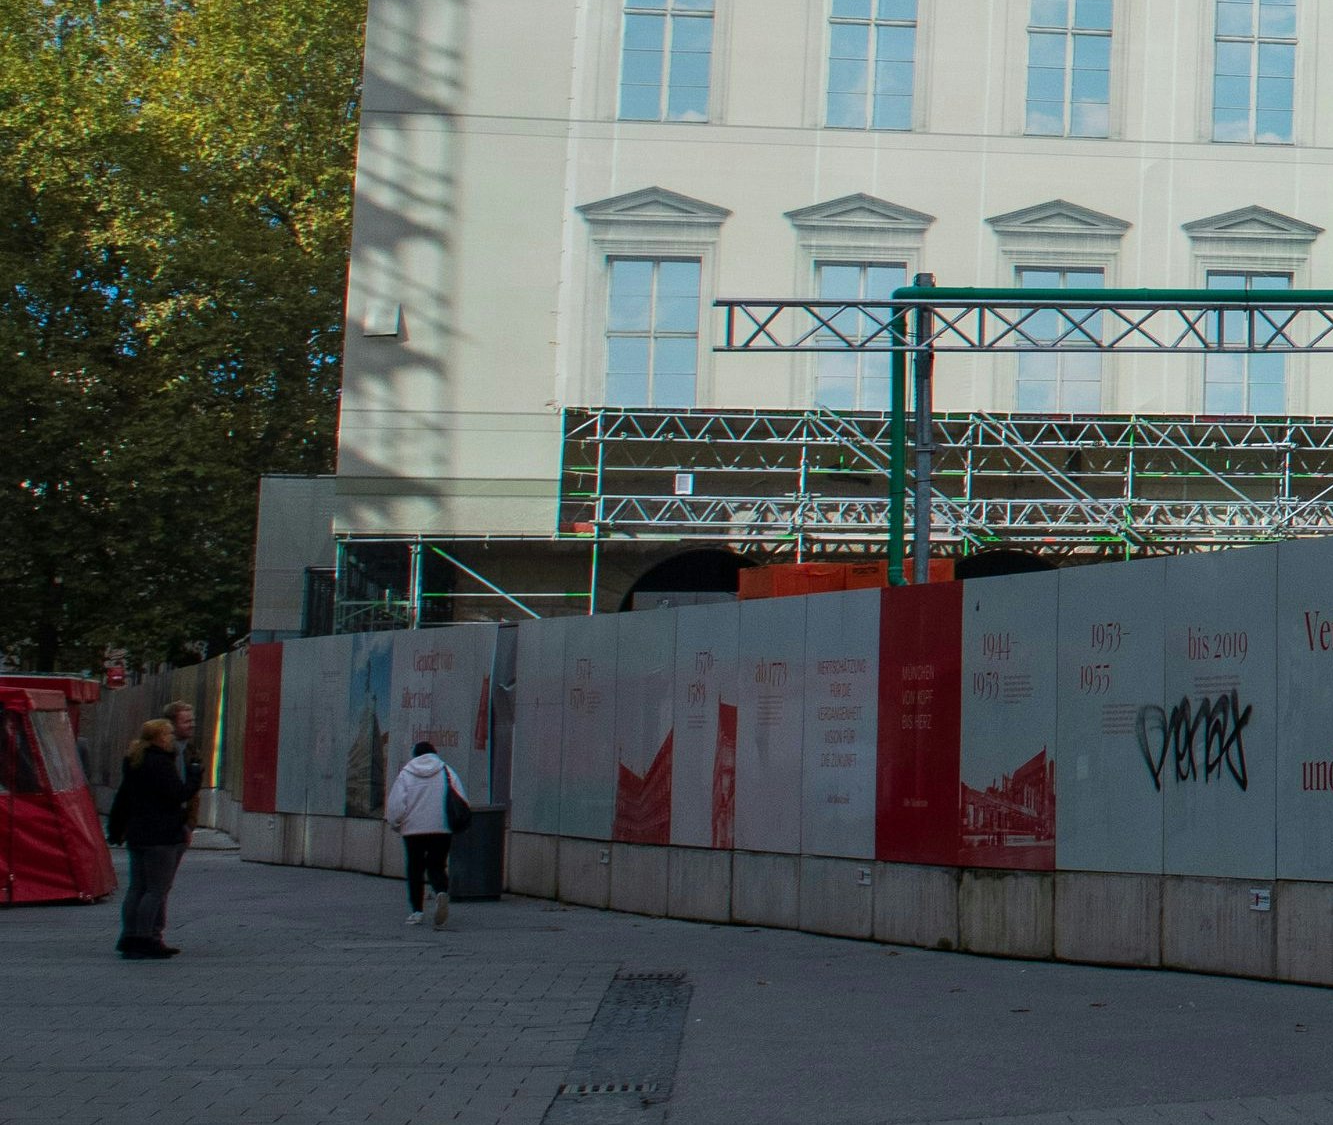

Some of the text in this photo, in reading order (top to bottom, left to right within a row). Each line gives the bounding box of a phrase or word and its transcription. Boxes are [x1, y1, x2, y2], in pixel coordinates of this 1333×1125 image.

[1188, 627, 1248, 664] bis 2019
[902, 663, 935, 681] MÜNCHEN
[973, 672, 1000, 700] 1953
[1079, 664, 1111, 696] 1955
